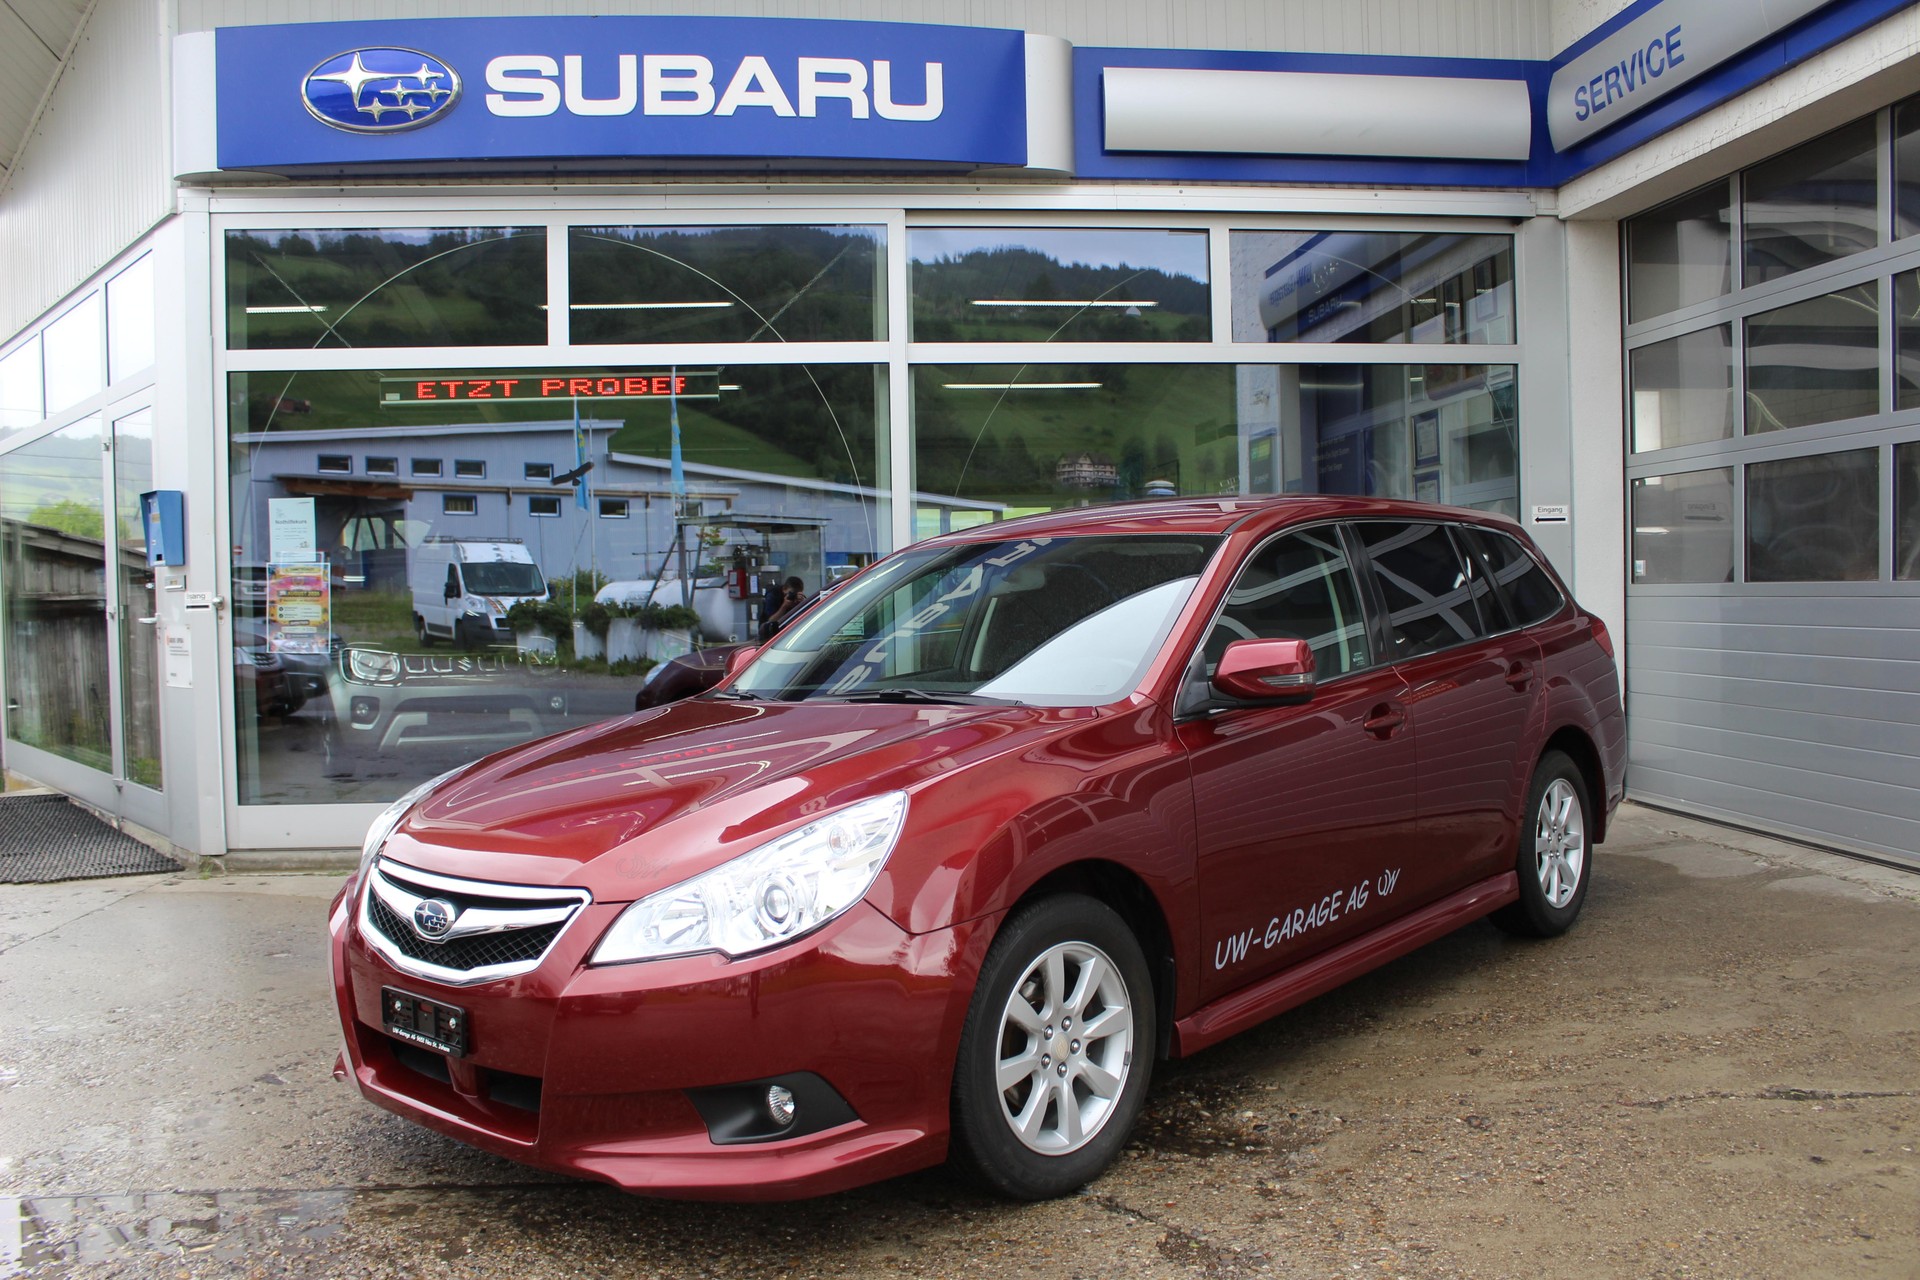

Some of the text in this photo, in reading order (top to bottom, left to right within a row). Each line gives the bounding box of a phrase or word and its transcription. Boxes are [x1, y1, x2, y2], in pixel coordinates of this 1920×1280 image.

[485, 54, 944, 122] SUBARU
[1574, 24, 1685, 121] SERVICE
[417, 380, 519, 399] ETZT
[1537, 506, 1563, 514] Eingang
[1215, 890, 1343, 970] UW-GARAGE
[1345, 879, 1370, 914] AG
